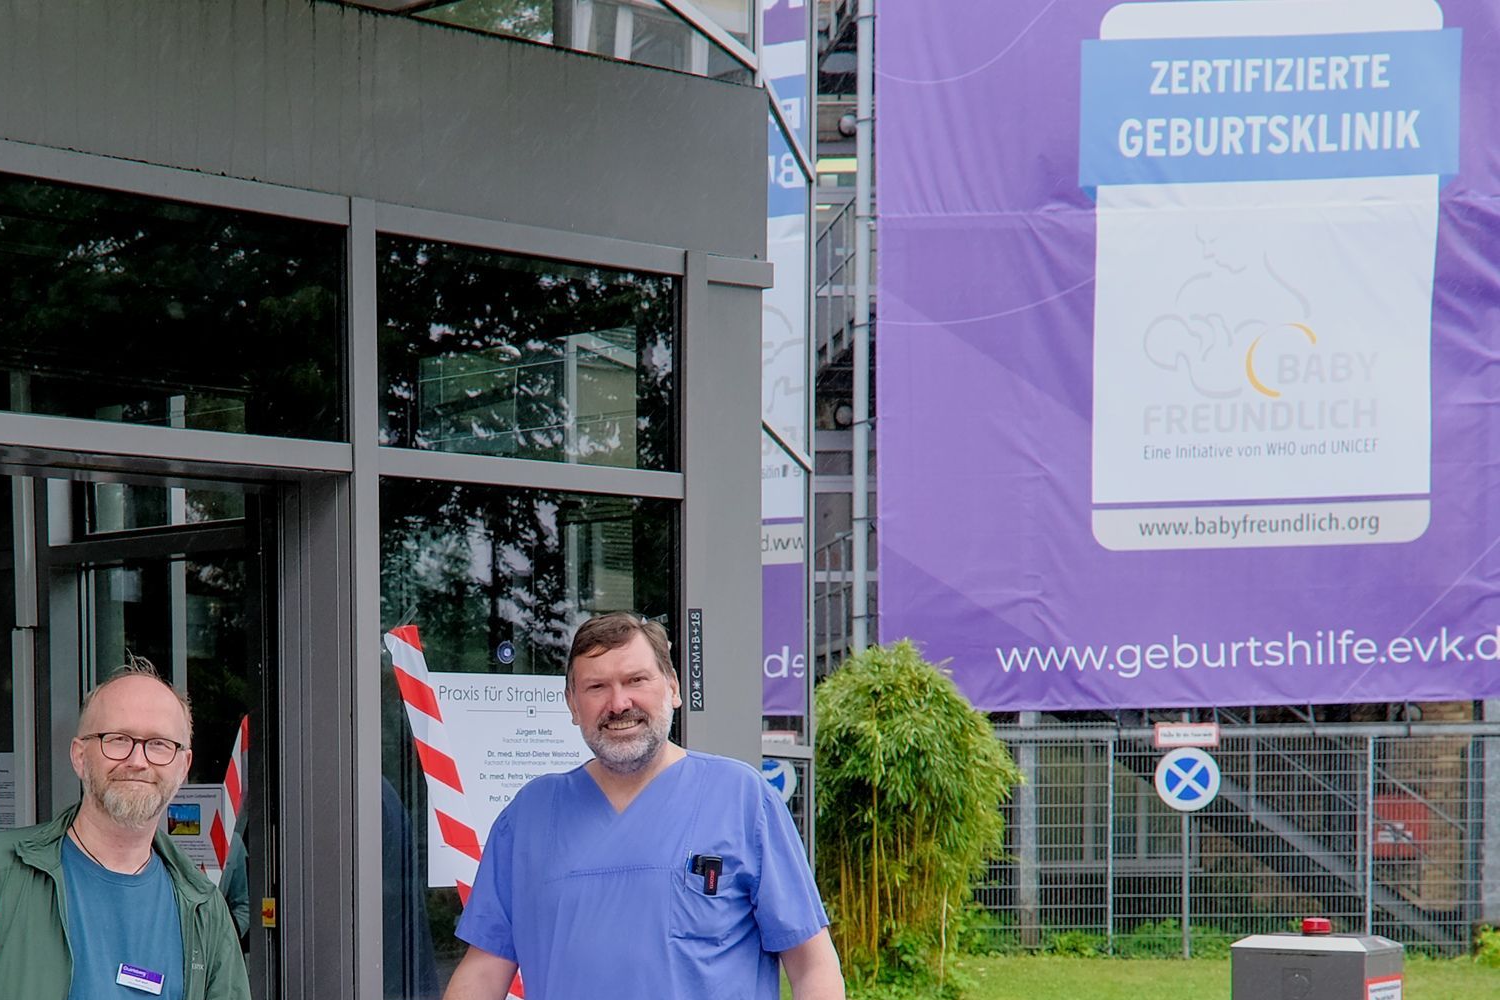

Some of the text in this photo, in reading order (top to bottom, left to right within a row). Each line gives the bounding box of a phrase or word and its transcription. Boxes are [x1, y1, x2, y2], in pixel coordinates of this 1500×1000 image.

[1149, 53, 1391, 96] ZERTIFIZIERTE
[1117, 110, 1421, 160] GEBURTSKLINIK
[1277, 351, 1379, 386] BABY
[1143, 398, 1379, 436] FREUNDLICH
[1143, 437, 1380, 461] Eine Initiative von WHO und UNICEF
[1138, 512, 1381, 540] www.babyfreundlich.org
[438, 685, 480, 702] Praxis
[484, 685, 503, 702] für
